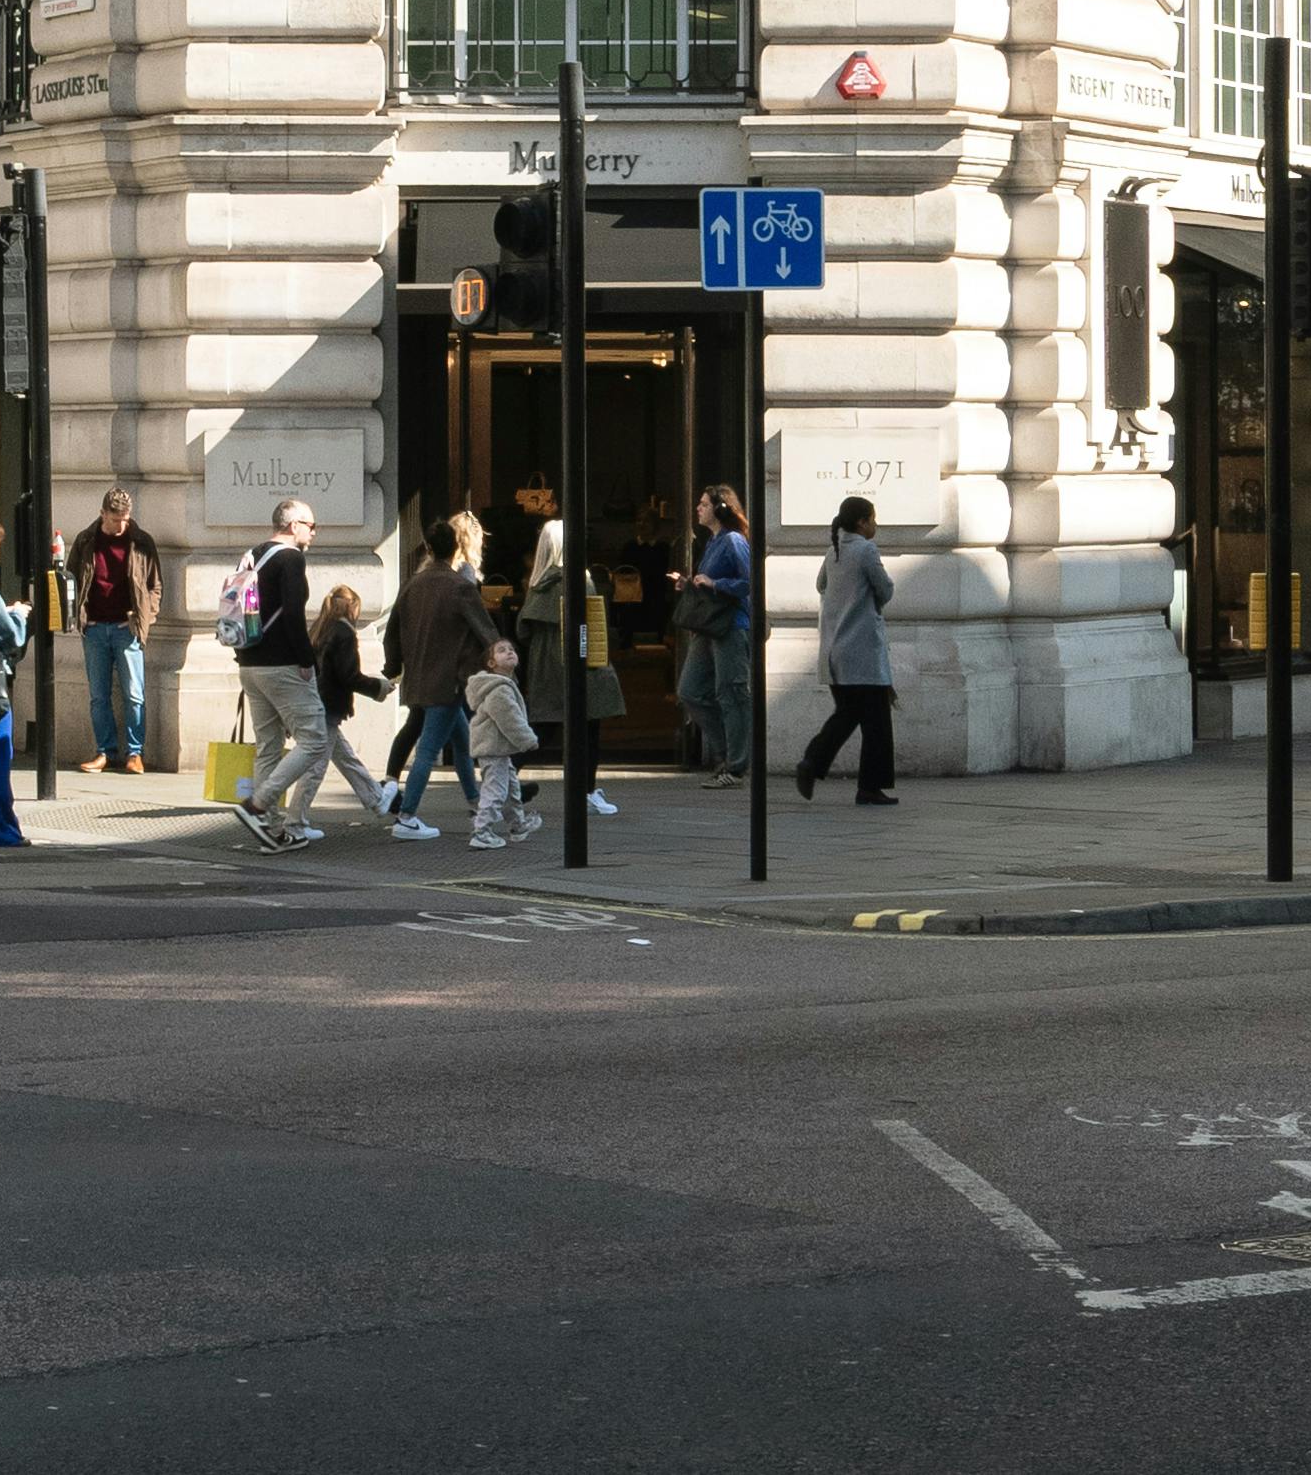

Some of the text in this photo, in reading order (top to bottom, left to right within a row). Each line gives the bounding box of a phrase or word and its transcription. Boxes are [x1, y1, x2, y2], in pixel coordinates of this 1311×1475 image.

[1069, 74, 1114, 100] REGENT
[1124, 83, 1163, 108] STREET
[512, 140, 641, 179] Muerry
[457, 279, 484, 315] 07
[1111, 285, 1145, 320] 100
[232, 458, 336, 493] Mulberry
[816, 459, 906, 486] EST. 1971
